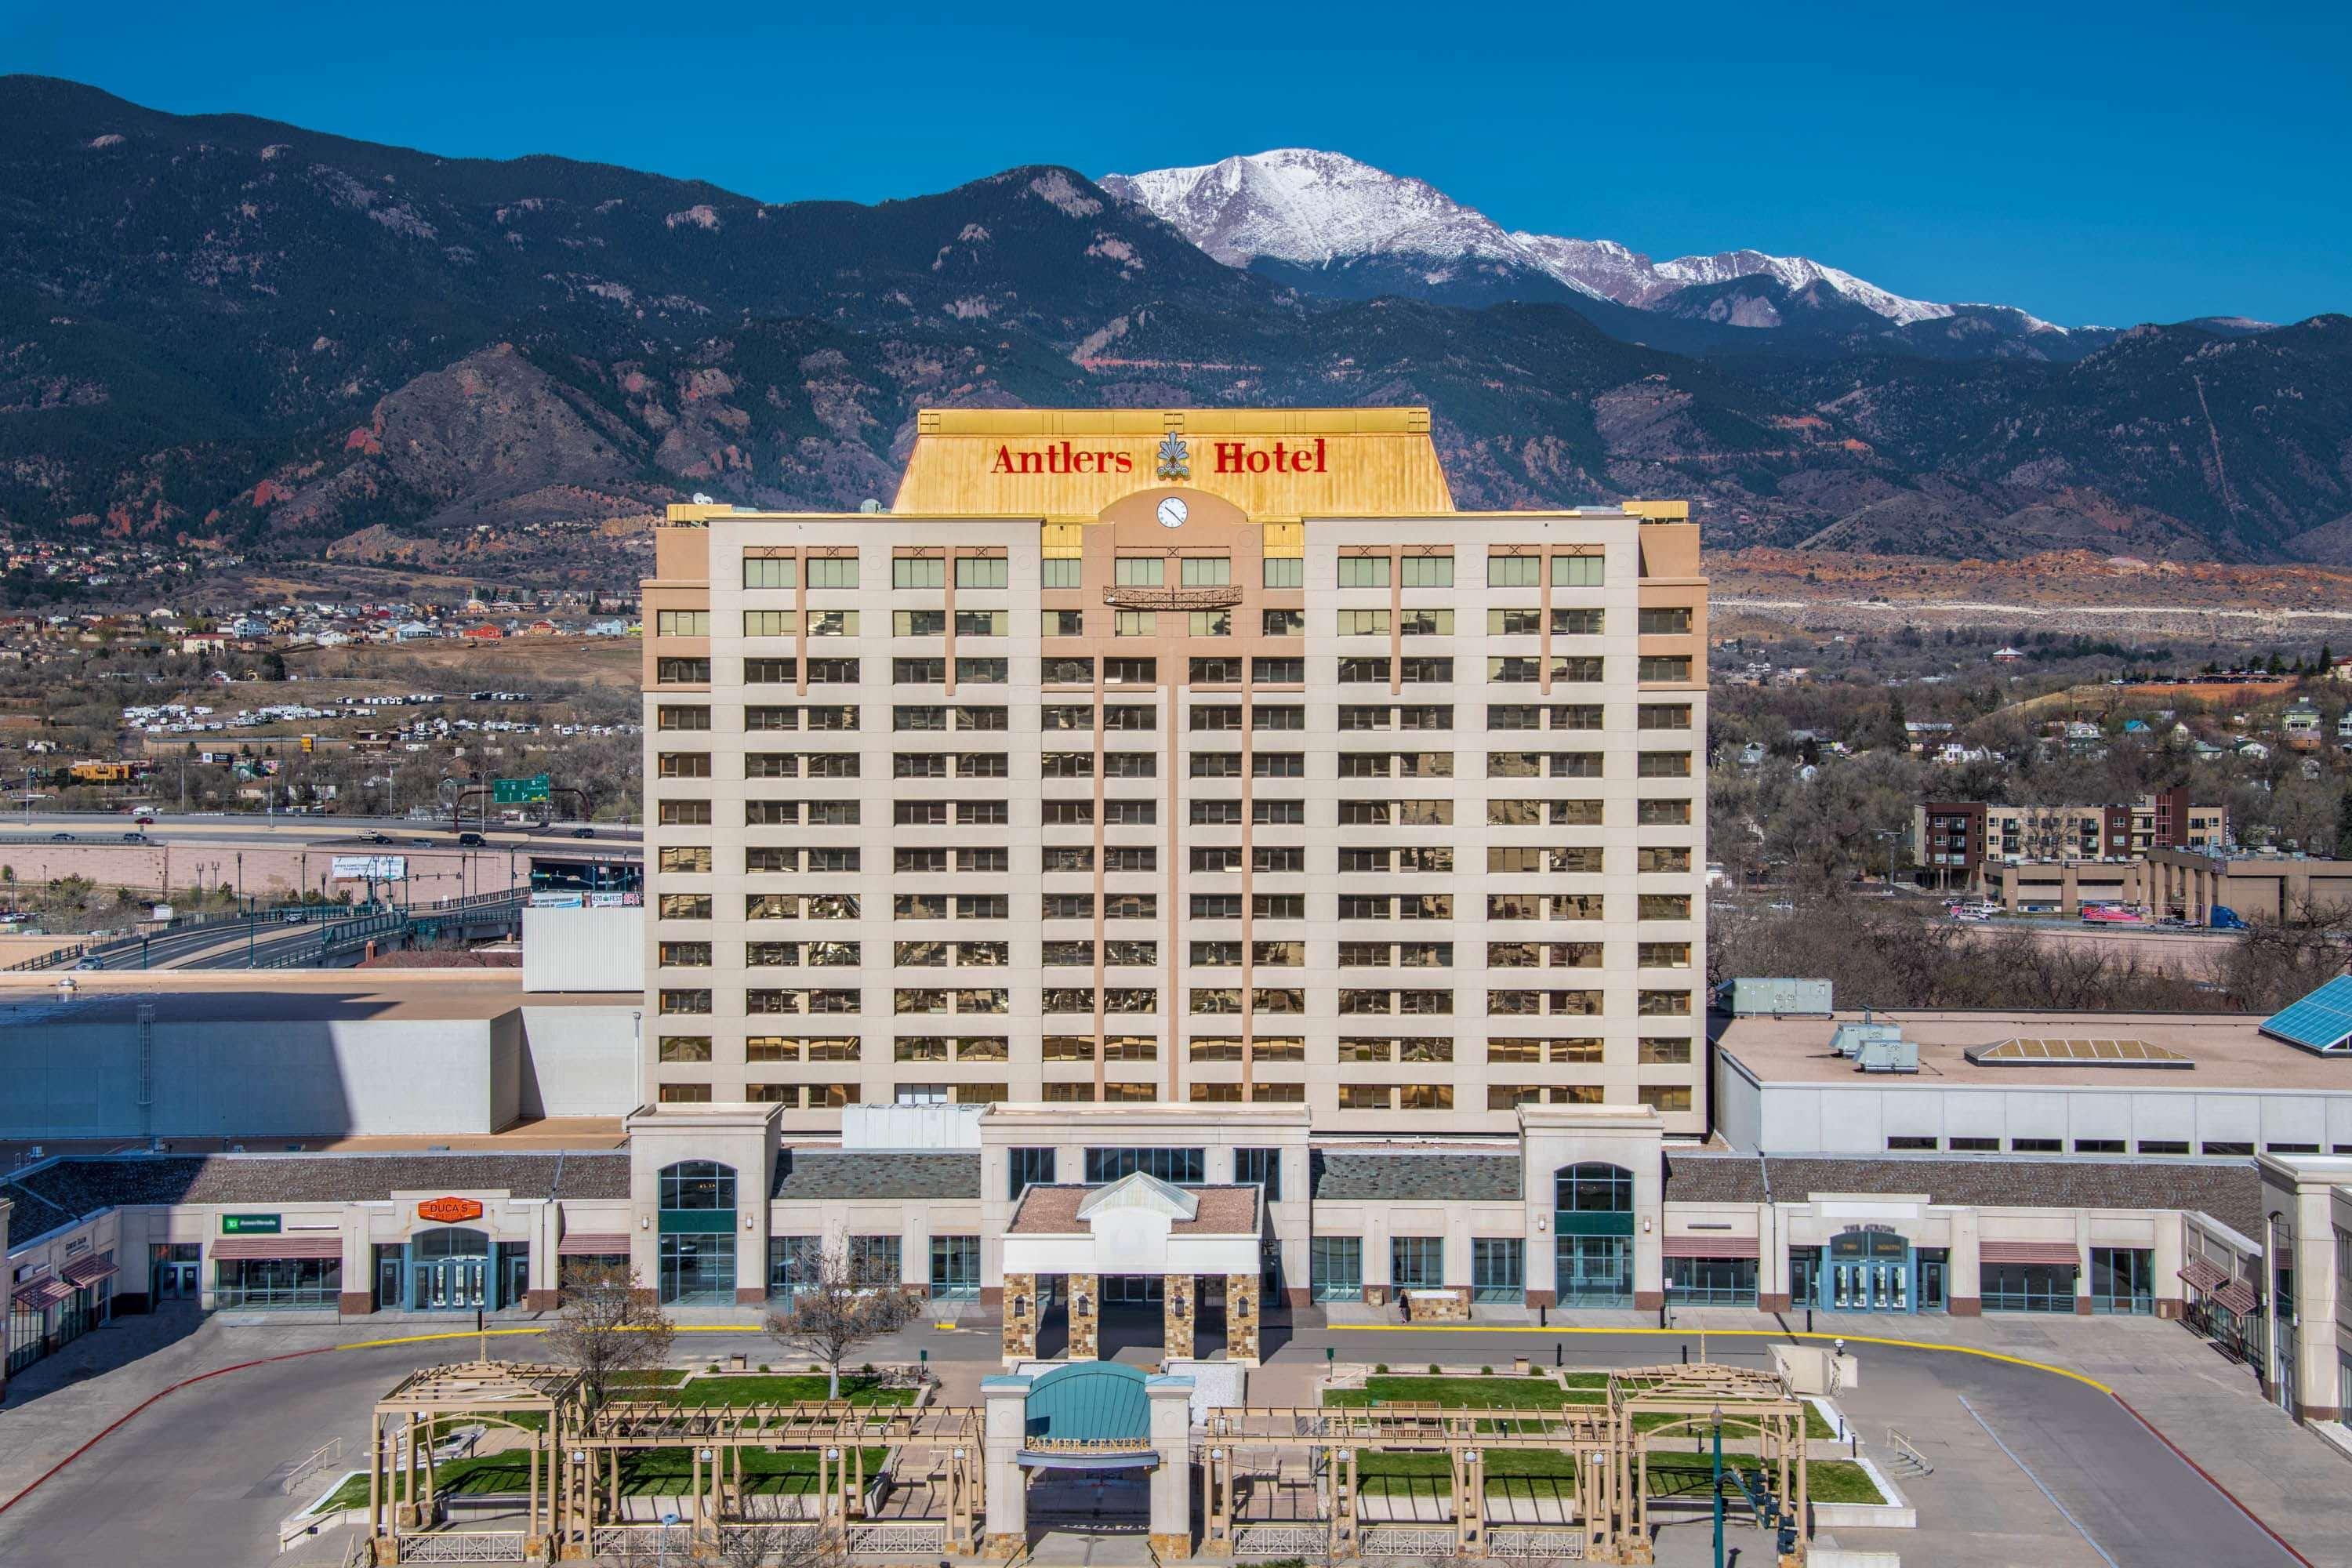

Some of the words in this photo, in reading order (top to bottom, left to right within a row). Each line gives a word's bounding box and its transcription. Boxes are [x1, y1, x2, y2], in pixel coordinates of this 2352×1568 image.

[992, 441, 1132, 474] Antlers
[1214, 438, 1327, 473] Hotel
[430, 1204, 468, 1213] DUCA'S
[1026, 1436, 1081, 1450] PALMER
[1088, 1437, 1150, 1450] CENTER
